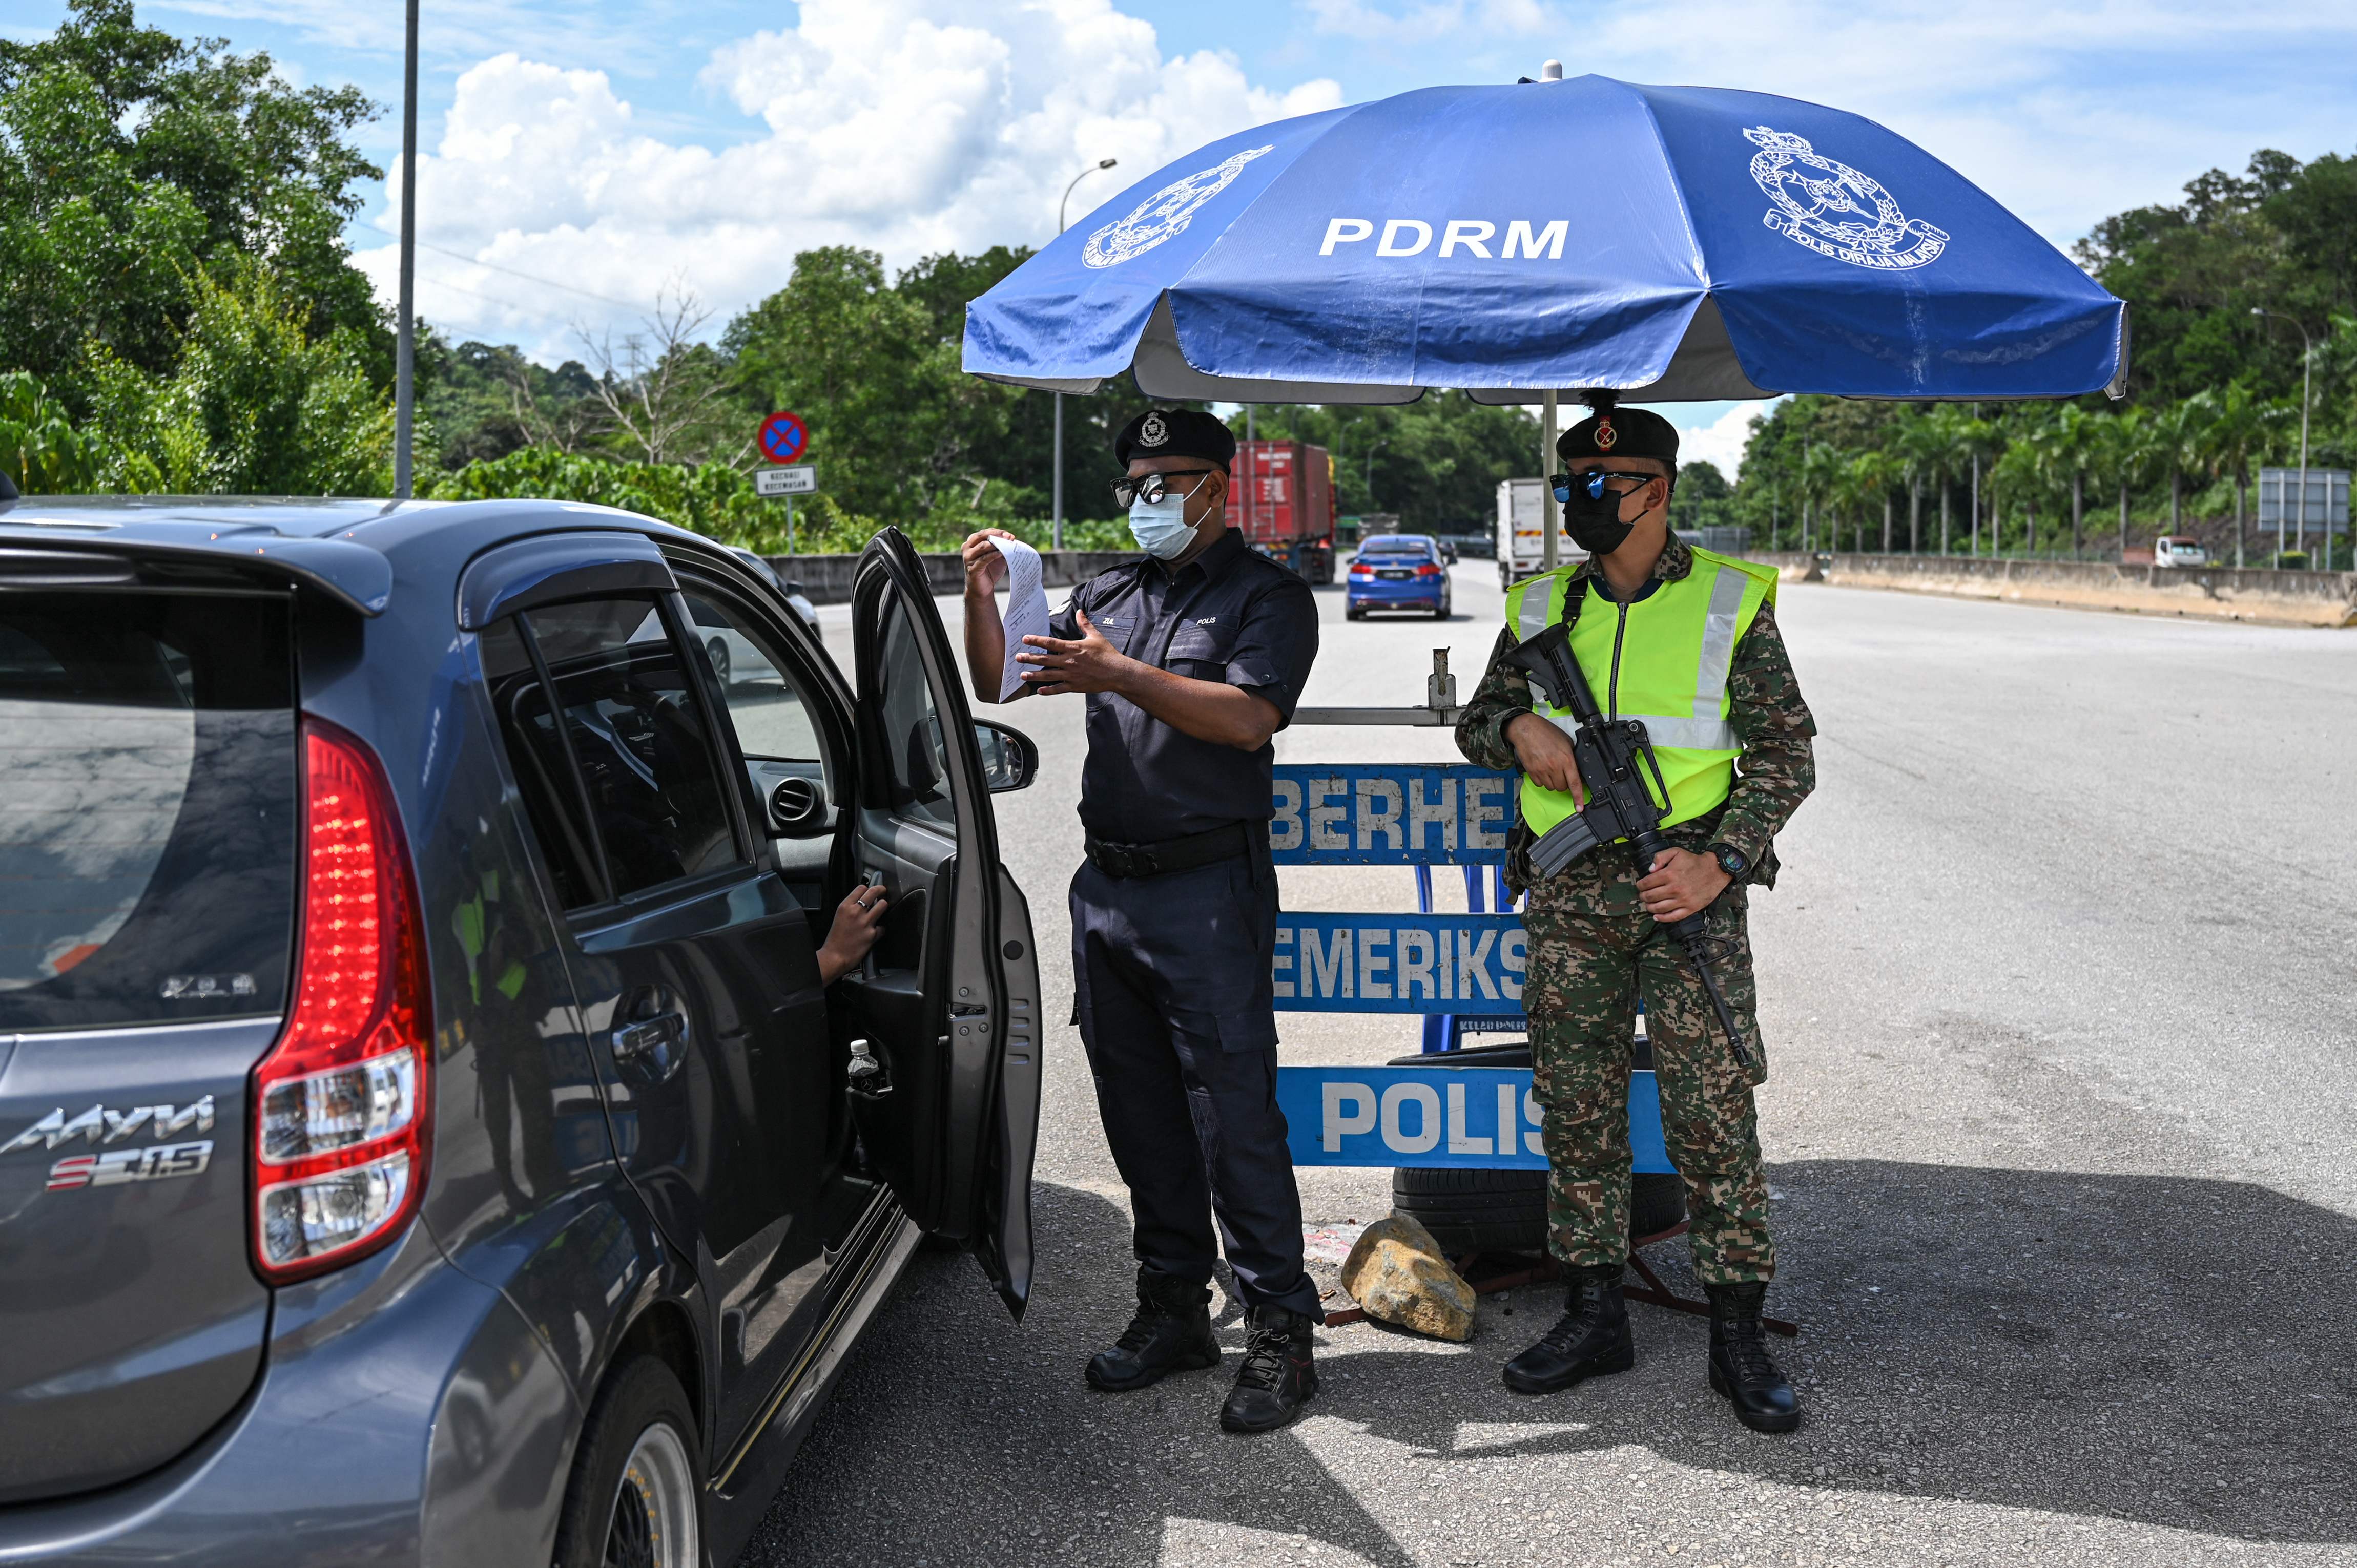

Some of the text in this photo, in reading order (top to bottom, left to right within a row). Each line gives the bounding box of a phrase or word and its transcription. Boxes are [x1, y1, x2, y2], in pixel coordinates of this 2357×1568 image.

[1319, 218, 1569, 259] PDRM
[1786, 228, 1941, 267] POLIS DIRAJA MALAYSIA
[1196, 617, 1216, 625] POLIS
[1268, 778, 1523, 850] BERHE
